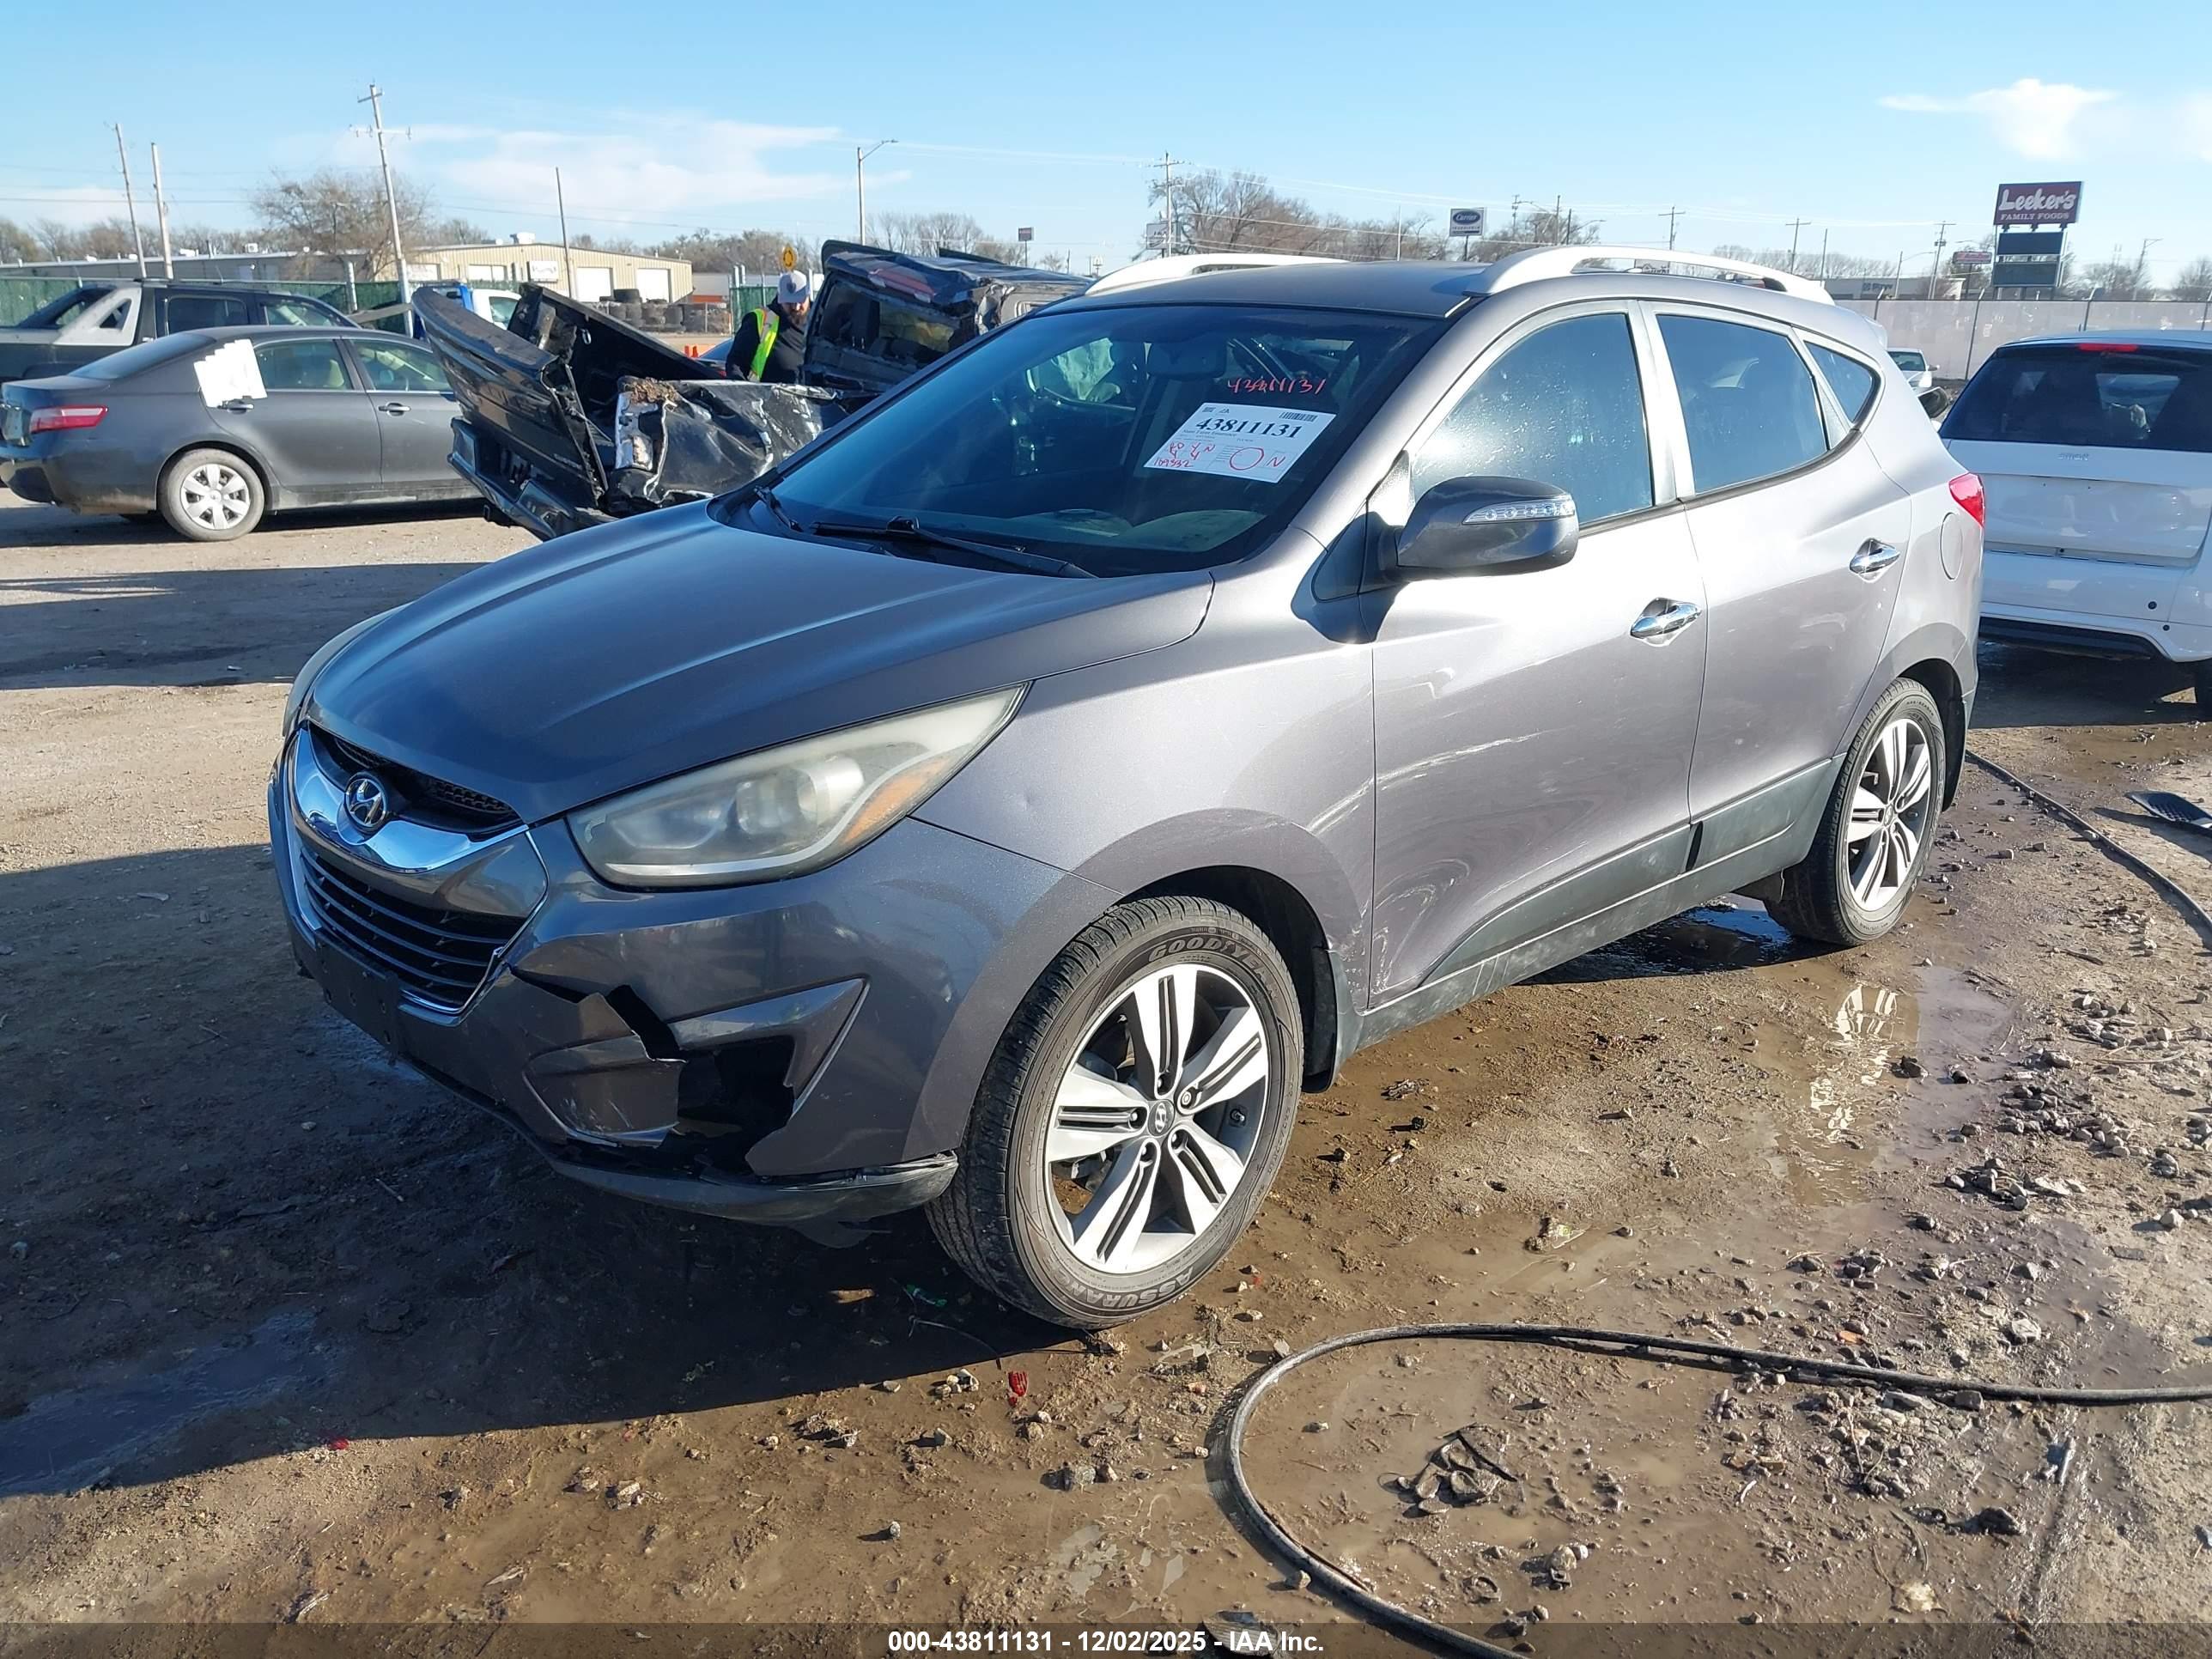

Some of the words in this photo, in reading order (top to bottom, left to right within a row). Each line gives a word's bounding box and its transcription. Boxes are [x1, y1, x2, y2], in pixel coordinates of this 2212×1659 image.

[1998, 188, 2076, 211] Leeker's
[1195, 417, 1303, 438] 43811131
[1148, 937, 1279, 1000] GOODYEAR
[1042, 1255, 1194, 1309] ASSURANCE
